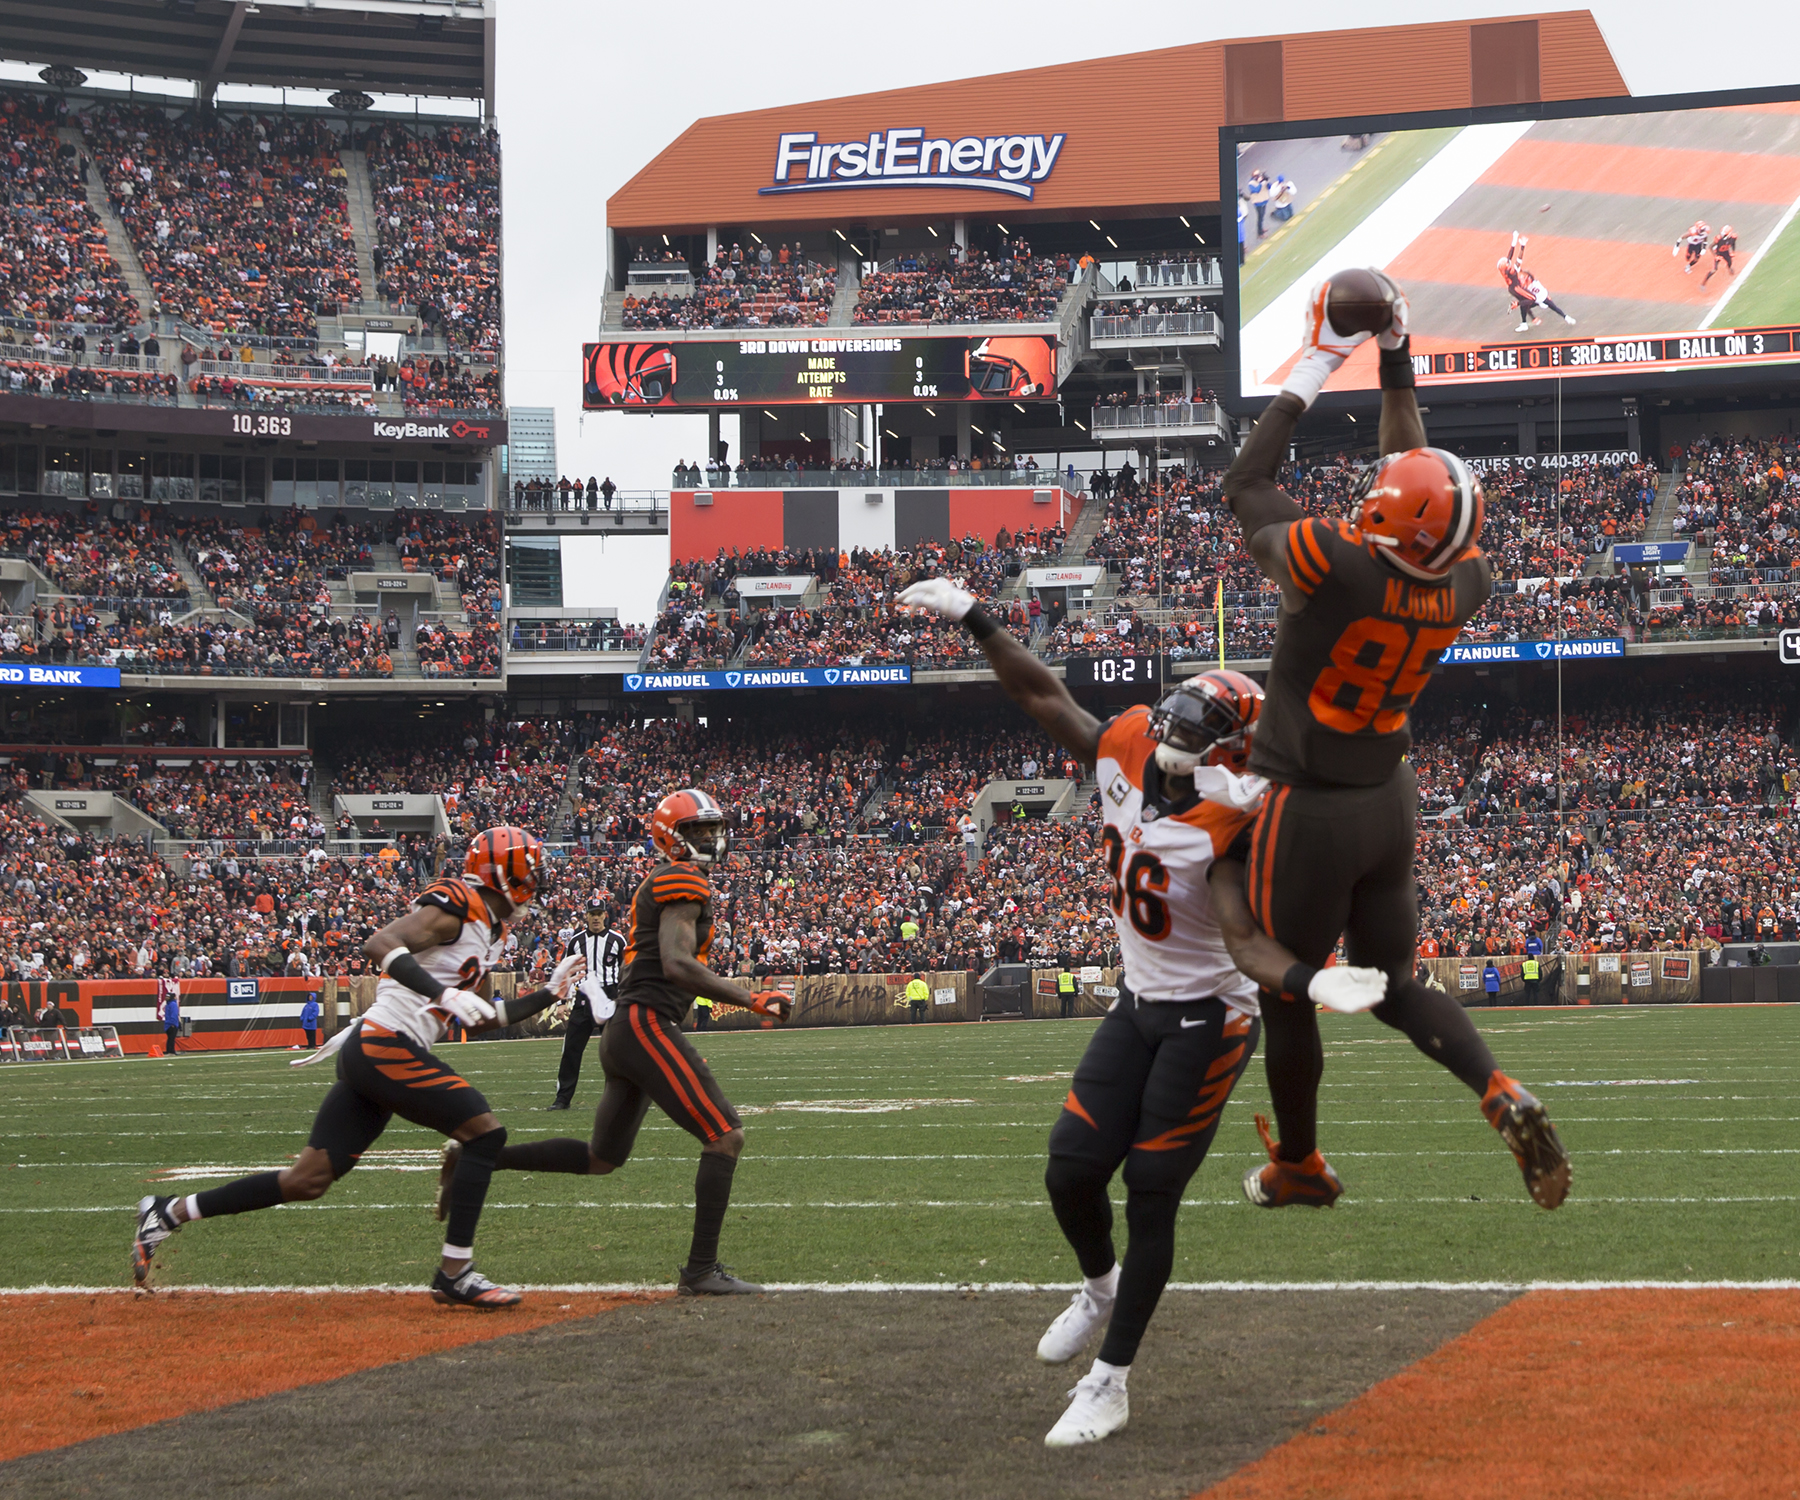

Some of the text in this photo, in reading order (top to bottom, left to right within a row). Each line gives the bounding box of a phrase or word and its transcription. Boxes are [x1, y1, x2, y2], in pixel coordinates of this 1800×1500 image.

[774, 127, 1067, 183] FirstEnergy
[740, 339, 901, 354] 3RD DOWN CONVERSIONS
[1570, 342, 1656, 365] 3RD & GOAL
[1680, 335, 1764, 358] BALL ON 3
[808, 358, 835, 369] MADE
[915, 357, 923, 368] 0
[1445, 354, 1456, 373] 0
[1489, 350, 1517, 370] CLE
[1529, 349, 1540, 367] 0
[716, 361, 724, 372] 0
[716, 375, 724, 386] 3
[797, 372, 846, 383] ATTEMPTS
[915, 371, 923, 382] 3
[713, 388, 738, 400] 0.0%
[809, 386, 834, 397] RATE
[913, 385, 938, 397] 0.0%
[232, 414, 291, 436] 10,363
[373, 422, 450, 439] KeyBank
[1382, 578, 1455, 623] NJOKU
[1454, 647, 1520, 660] FANDUEL
[1554, 643, 1621, 656] FANDUEL
[29, 668, 82, 683] BANK
[843, 670, 907, 682] FANDUEL
[1094, 659, 1152, 682] 10:21
[1308, 616, 1463, 733] 85
[645, 676, 710, 687] FANDUEL
[744, 673, 808, 685] FANDUEL
[836, 985, 886, 1008] LAND
